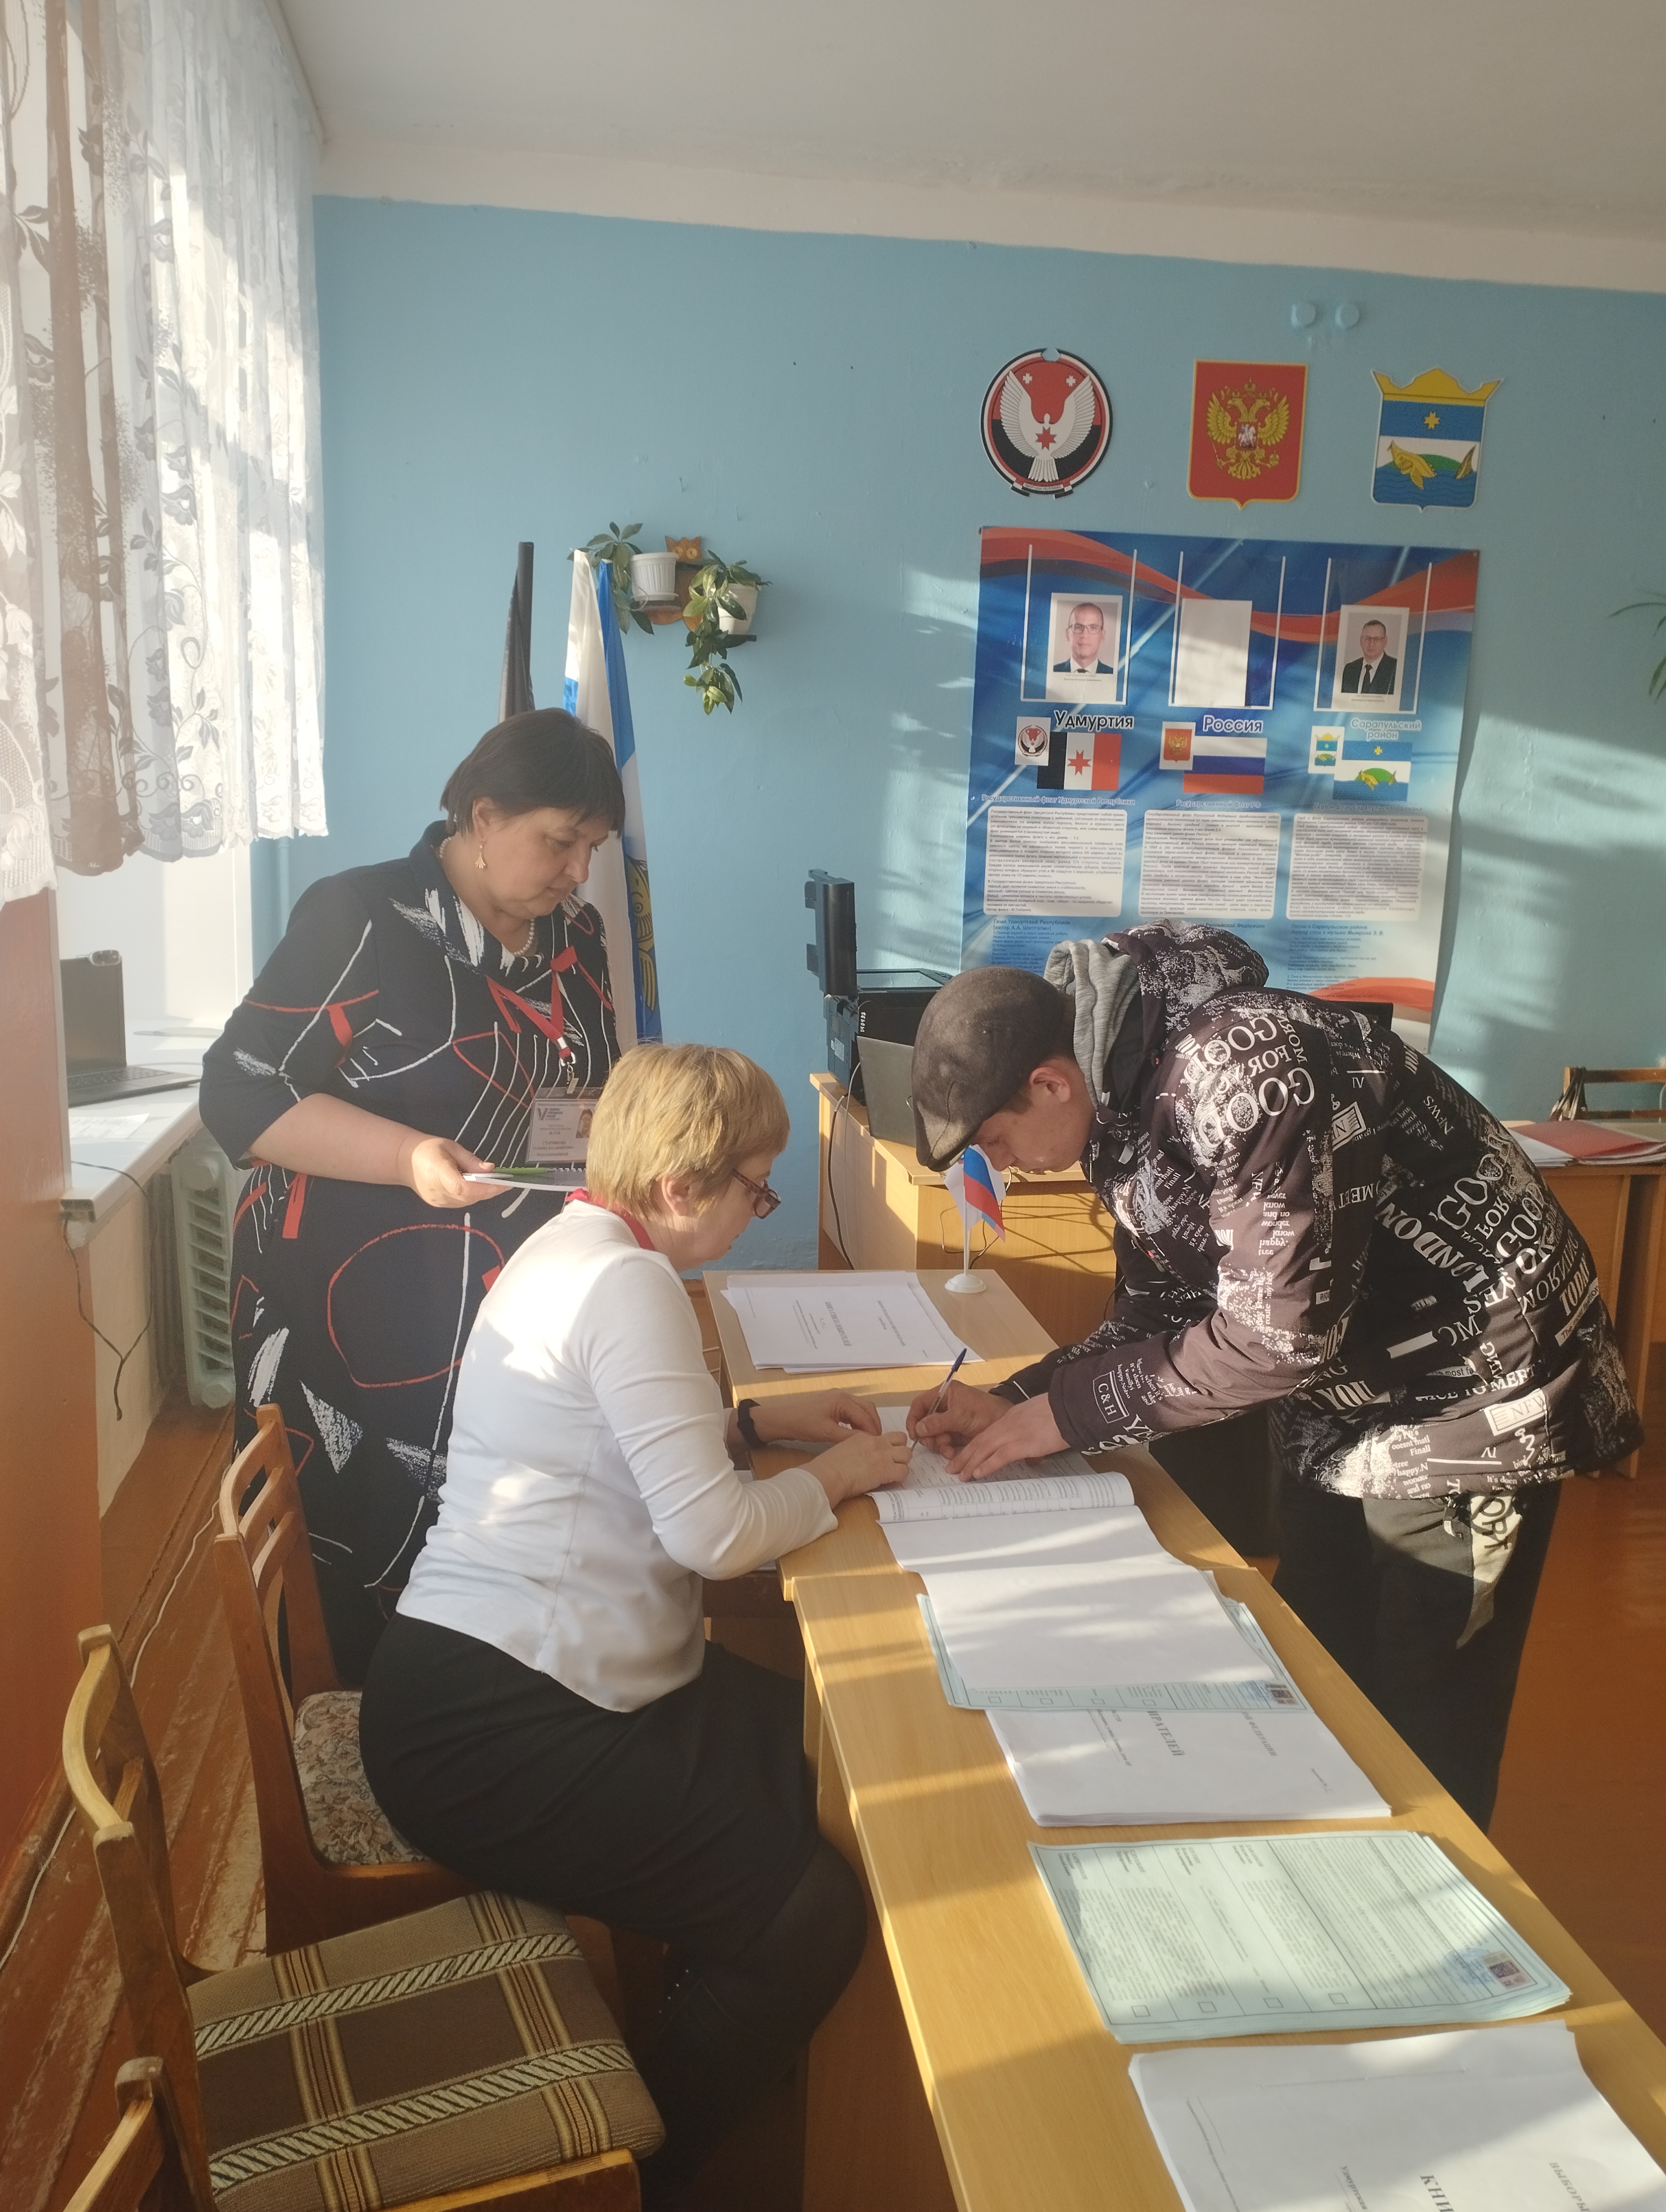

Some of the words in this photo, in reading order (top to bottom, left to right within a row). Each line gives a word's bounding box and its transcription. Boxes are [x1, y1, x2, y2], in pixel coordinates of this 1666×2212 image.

[1055, 711, 1133, 730] Удмуртия
[1203, 715, 1263, 732] Россия
[1351, 719, 1421, 732] Сарапульский
[1367, 732, 1398, 741] район
[982, 795, 1039, 803] Государственный
[1041, 796, 1056, 805] флаг
[1374, 1202, 1490, 1293] LONDON
[1141, 1395, 1153, 1406] and
[1315, 1380, 1375, 1410] YOU
[1410, 1445, 1431, 1456] Finall
[1407, 1485, 1420, 1495] and
[1148, 1711, 1186, 1756] ИРАТЕЛЕЙ
[1340, 2164, 1367, 2210] Удмуртская
[1420, 2174, 1455, 2212] КНИ
